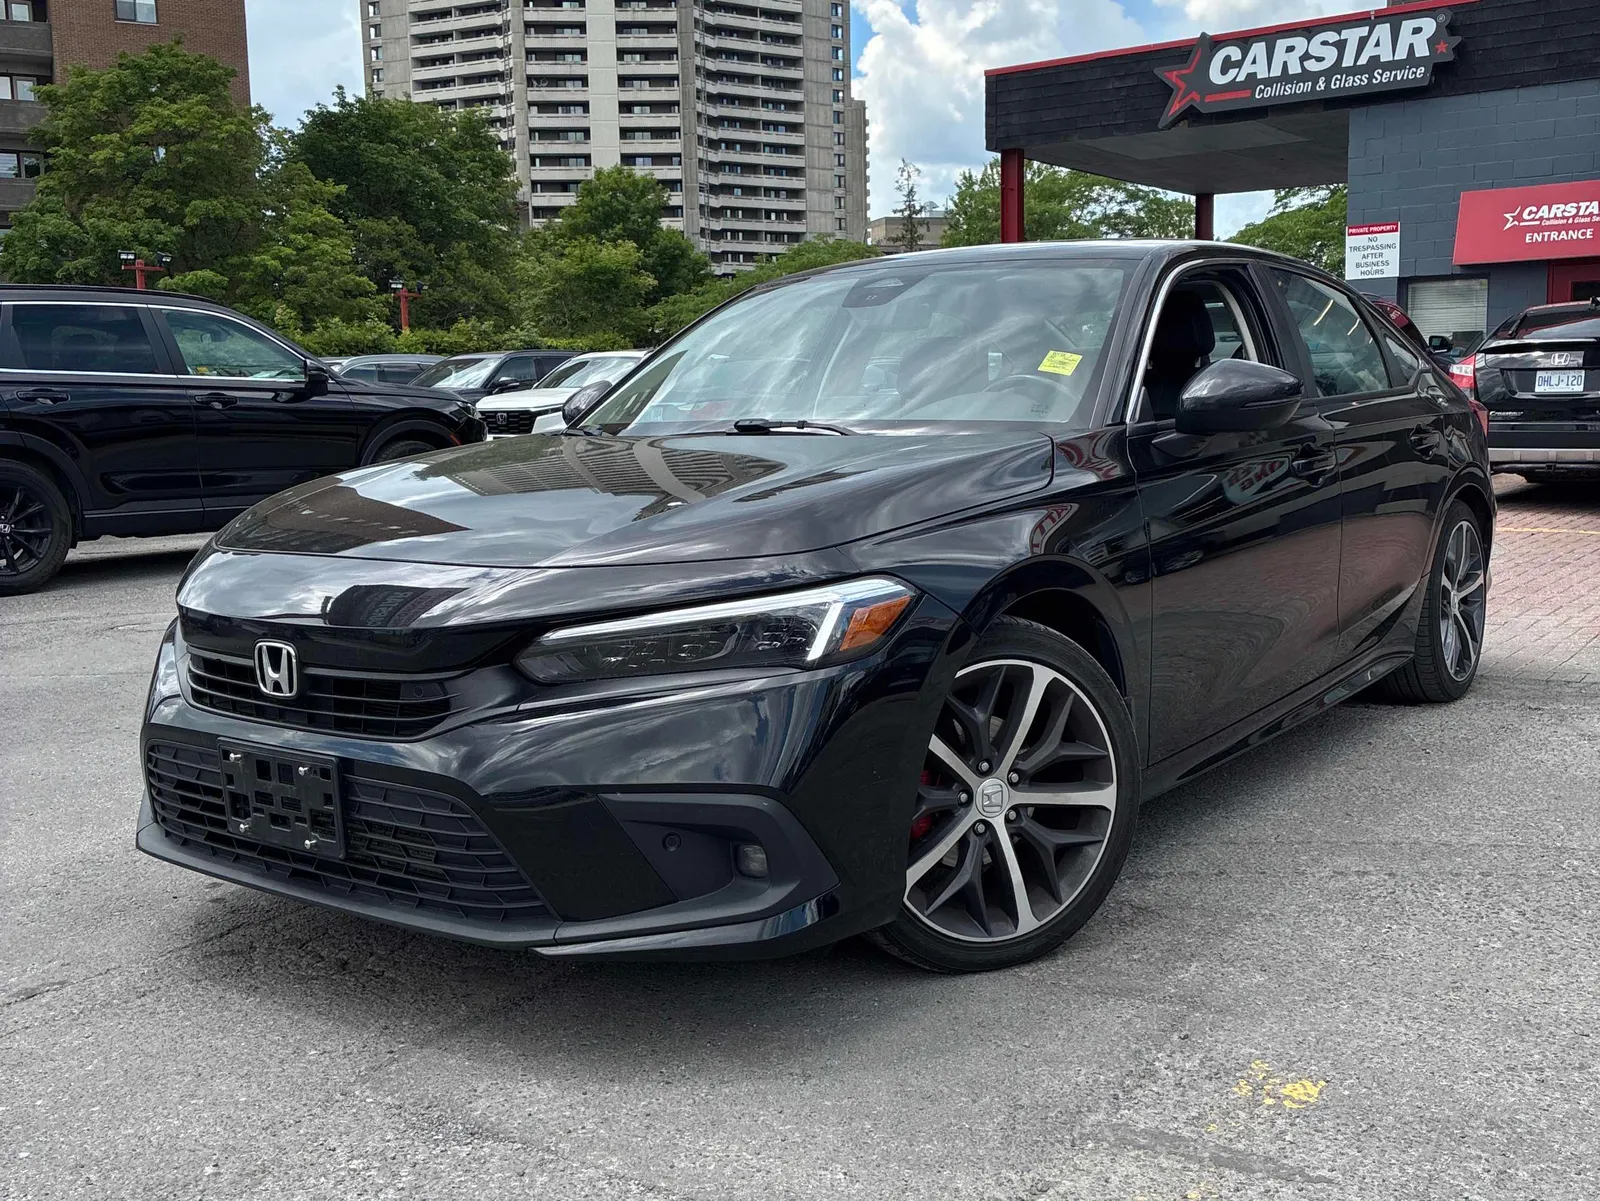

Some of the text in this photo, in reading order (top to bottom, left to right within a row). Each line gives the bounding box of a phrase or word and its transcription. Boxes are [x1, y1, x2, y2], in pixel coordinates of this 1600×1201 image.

[1209, 17, 1436, 85] CARSTAR
[1255, 66, 1425, 99] Collision & Glass Service
[1541, 218, 1567, 226] Collision
[1525, 228, 1594, 243] ENTRANCE
[1349, 243, 1397, 252] TRESPASSING
[1361, 252, 1384, 260] AFTER
[1355, 260, 1390, 268] BUSINESS
[1360, 268, 1385, 276] HOURS
[1537, 374, 1582, 387] DHLJ 120
